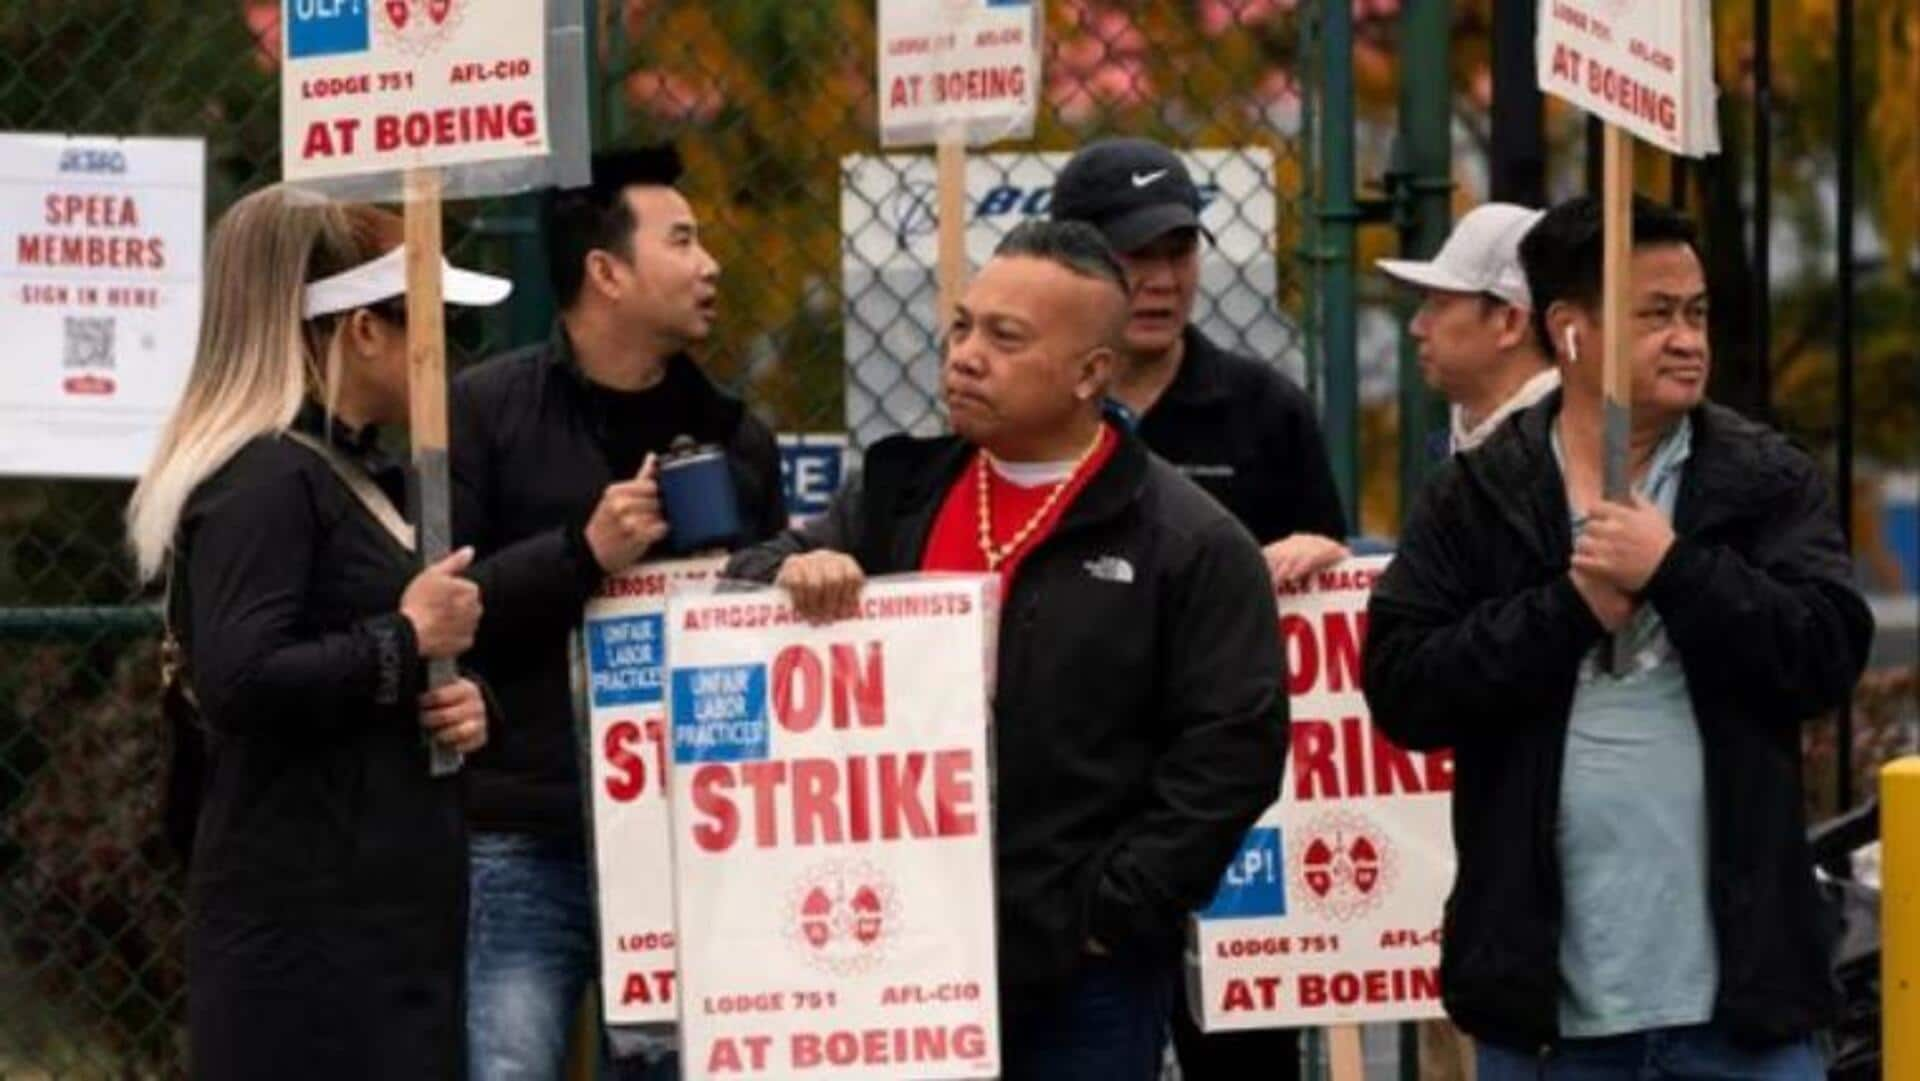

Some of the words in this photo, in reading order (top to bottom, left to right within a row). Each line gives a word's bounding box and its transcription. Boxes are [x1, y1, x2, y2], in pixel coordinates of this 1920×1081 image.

[302, 76, 370, 98] LODGE
[378, 72, 414, 90] 751
[450, 60, 531, 84] AFL-CIO
[890, 76, 923, 108] AT
[932, 66, 1025, 103] BOEING
[1553, 42, 1581, 84] AT
[1588, 60, 1676, 132] BOEING
[303, 118, 360, 158] AT
[375, 101, 537, 151] BOEING
[45, 194, 138, 227] SPEEA
[17, 233, 165, 269] MEMBERS
[21, 284, 69, 304] SIGN
[77, 288, 97, 304] IN
[108, 288, 157, 308] HERE
[609, 643, 652, 667] LABOR
[1279, 612, 1370, 695] ON
[690, 669, 749, 694] UNFAIR
[771, 641, 886, 733] ON
[694, 694, 747, 720] LABOR
[691, 750, 978, 851] STRIKE
[618, 932, 675, 952] LODG
[1217, 937, 1290, 958] LODGE
[1299, 935, 1339, 952] 751
[621, 971, 676, 1006] AT
[704, 992, 784, 1015] LODGE
[793, 991, 837, 1010] 751
[881, 983, 980, 1006] AFL-CIO
[1222, 977, 1281, 1012] AT
[1298, 967, 1441, 1007] BOEIN
[707, 1036, 772, 1072] AT
[790, 1025, 987, 1069] BOEING
